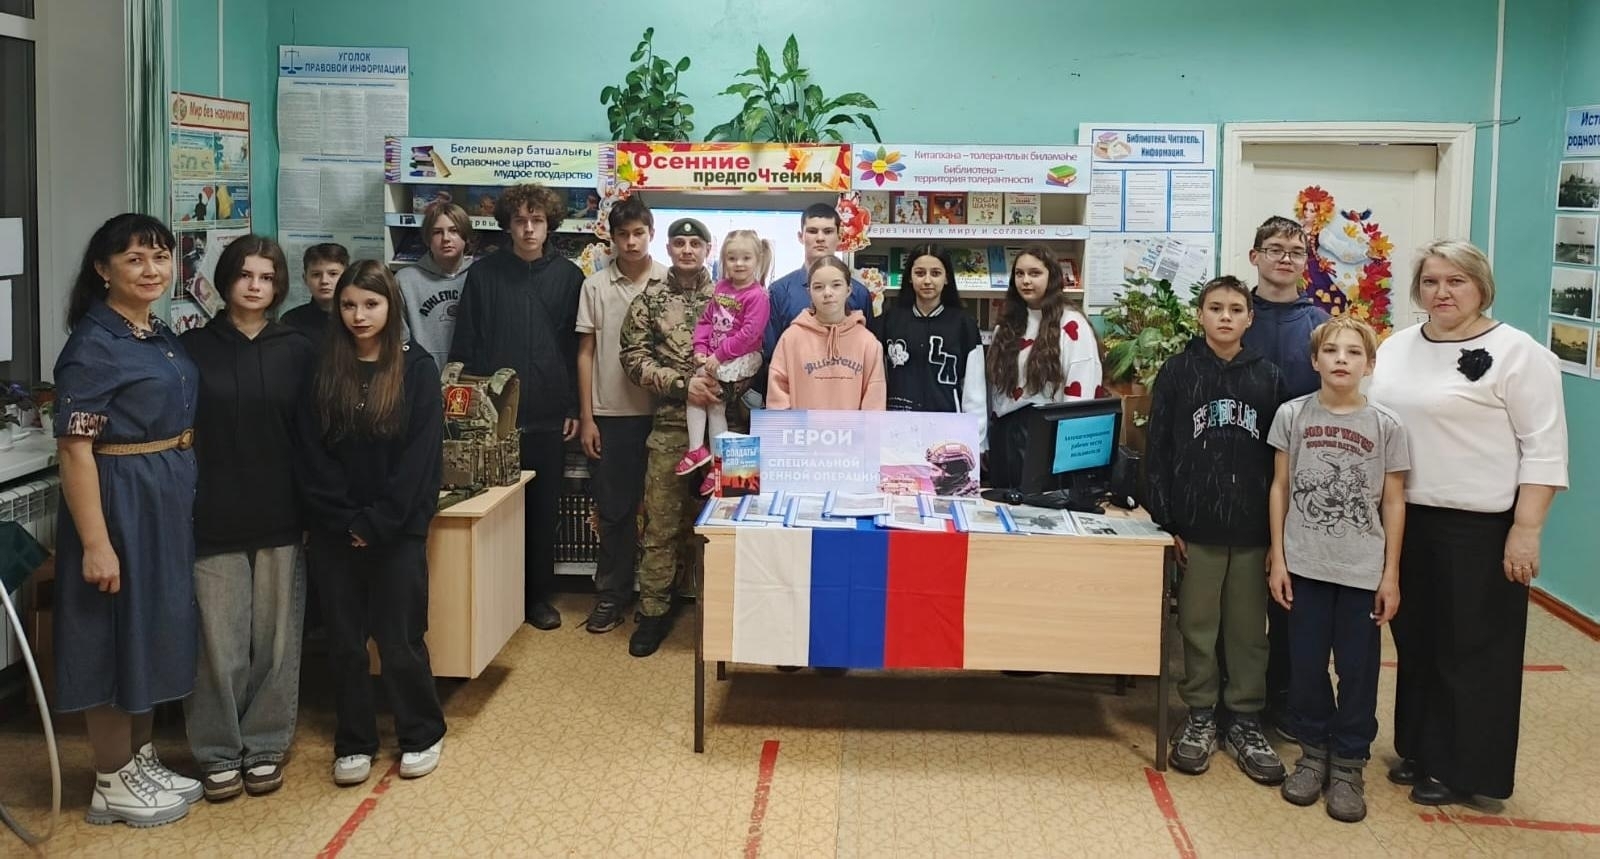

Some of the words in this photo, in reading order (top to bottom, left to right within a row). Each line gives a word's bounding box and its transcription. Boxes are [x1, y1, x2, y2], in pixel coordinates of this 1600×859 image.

[338, 52, 371, 62] УГОЛОК
[349, 63, 407, 75] ИНФОРМАЦИИ
[189, 101, 203, 120] Мир
[203, 104, 214, 118] без
[1580, 111, 1600, 126] Ист
[633, 152, 750, 170] Осенние
[913, 150, 962, 161] Китапхана
[969, 152, 1029, 162] толерантлык
[450, 156, 511, 167] Справочное
[512, 158, 552, 169] царство
[493, 169, 532, 180] мудрое
[533, 170, 593, 180] государство
[943, 164, 997, 175] Библиотека
[692, 168, 823, 186] предпоЧтения
[913, 175, 967, 184] территория
[968, 175, 1034, 185] толерантности
[902, 226, 934, 236] книгу
[949, 227, 977, 236] миру
[992, 226, 1046, 236] согласию
[419, 289, 459, 317] ATHLETIC
[782, 428, 852, 446] ГЕРОИ
[768, 457, 860, 469] СПЕЦИАЛЬНОЙ
[760, 470, 811, 482] ОЕННОЙ
